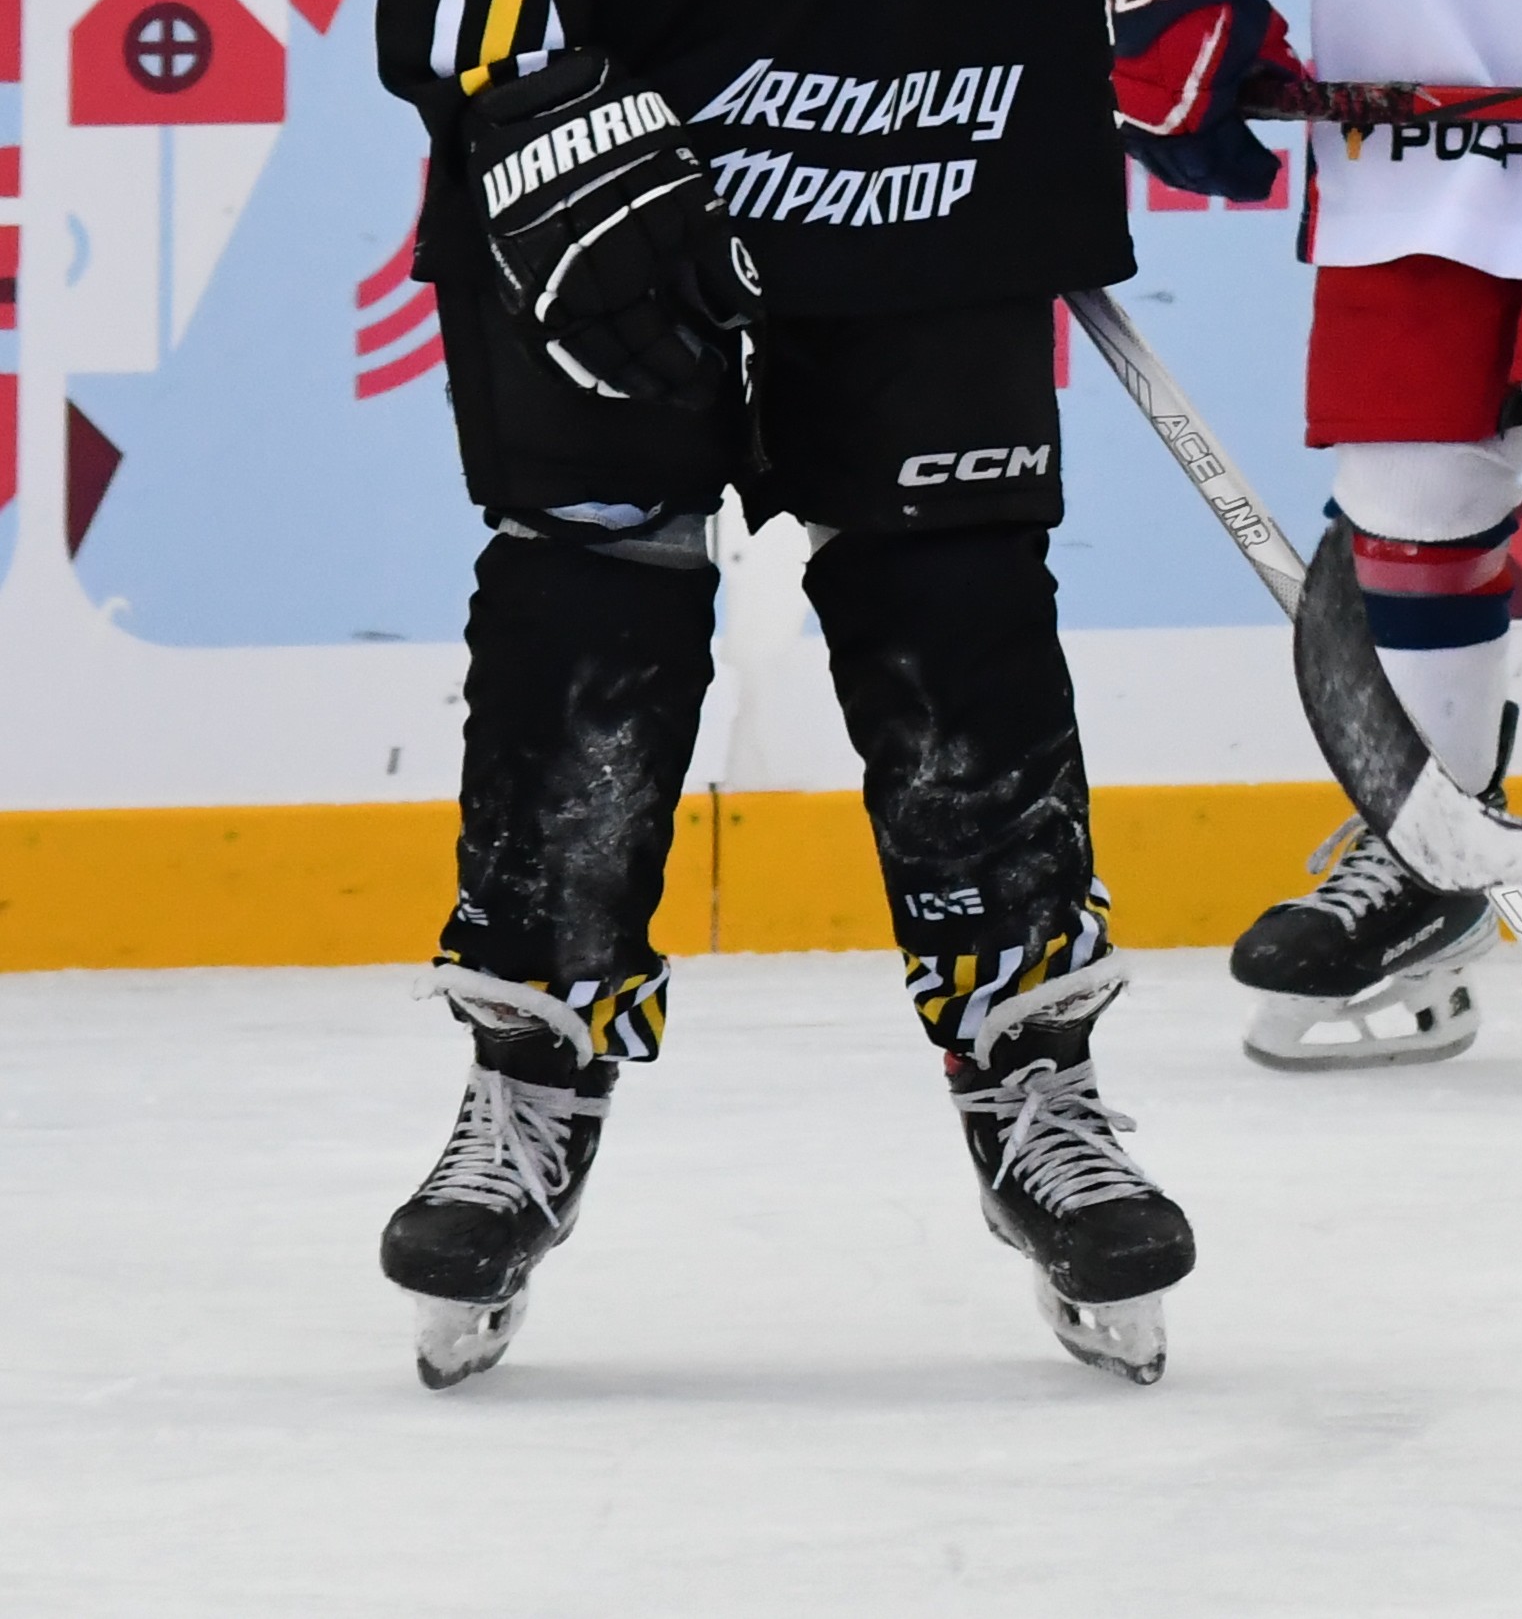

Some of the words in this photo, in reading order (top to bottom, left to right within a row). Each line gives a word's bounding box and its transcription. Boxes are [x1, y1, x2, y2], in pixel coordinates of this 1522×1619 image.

[897, 444, 1052, 488] CCM
[1151, 415, 1226, 484] ACE
[1211, 496, 1271, 549] JNR
